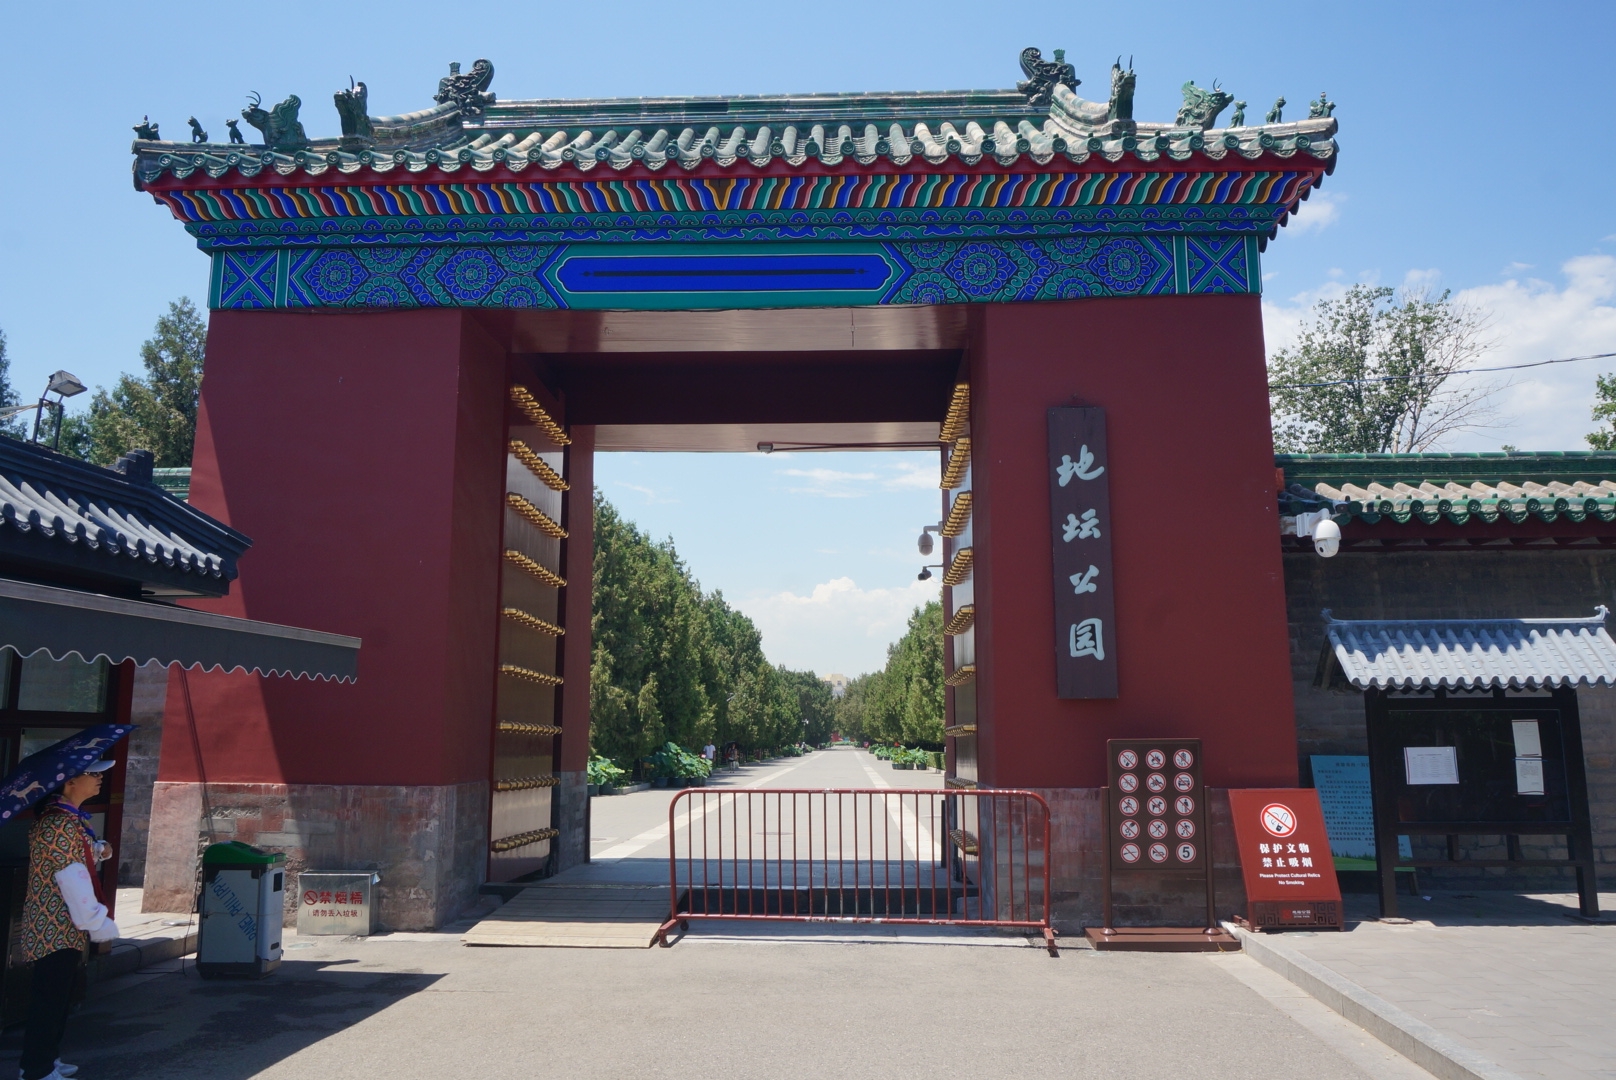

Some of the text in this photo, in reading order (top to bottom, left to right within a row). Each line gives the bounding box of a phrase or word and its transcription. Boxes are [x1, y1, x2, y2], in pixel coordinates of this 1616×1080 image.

[1056, 444, 1105, 661] 地坛公园
[1182, 846, 1190, 859] 5
[1259, 843, 1310, 854] 保护文物
[1262, 857, 1313, 868] 禁止吸烟
